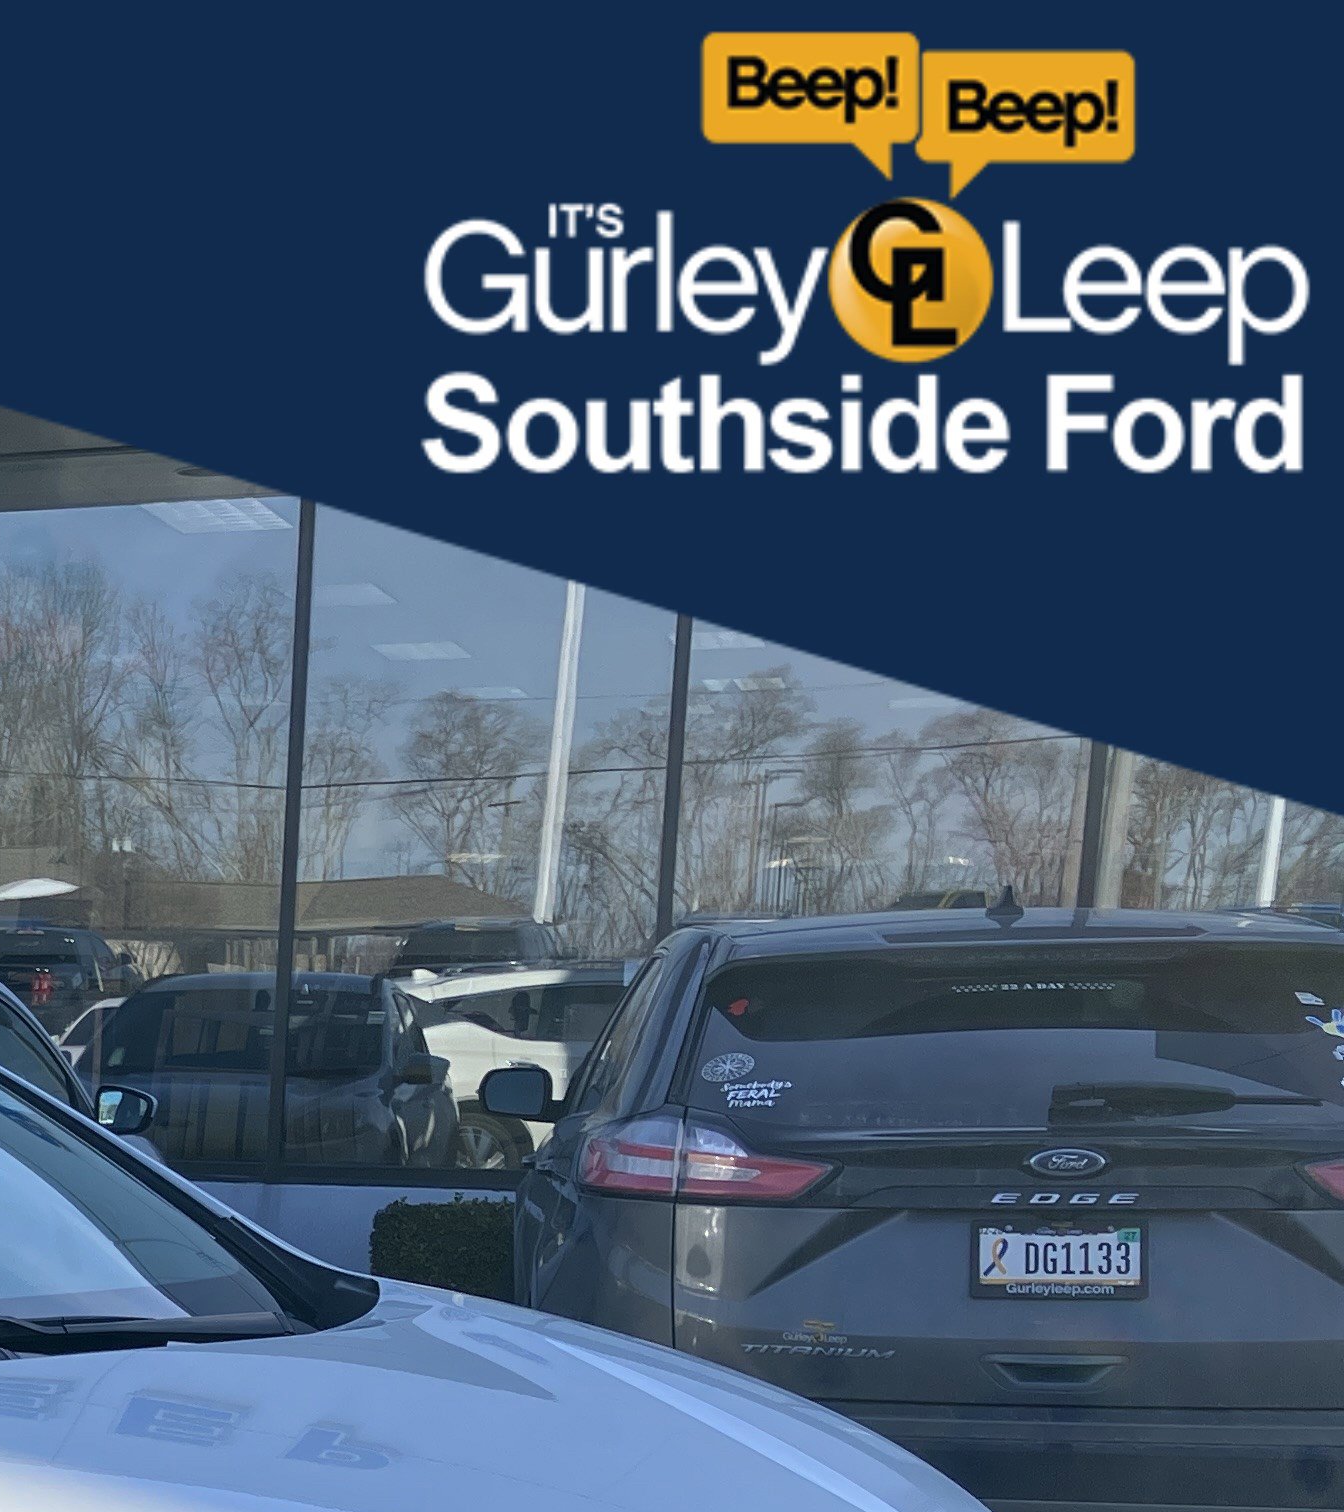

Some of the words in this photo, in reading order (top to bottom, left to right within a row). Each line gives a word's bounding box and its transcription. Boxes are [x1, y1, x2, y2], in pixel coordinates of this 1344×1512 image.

[1036, 982, 1065, 990] DAY
[726, 1088, 781, 1101] FERAL
[1048, 1154, 1088, 1170] Ford
[990, 1192, 1140, 1205] EDGE
[1025, 1242, 1131, 1275] DG1133
[1006, 1282, 1115, 1297] Gurleyleep.com
[741, 1343, 896, 1359] TITANIUM
